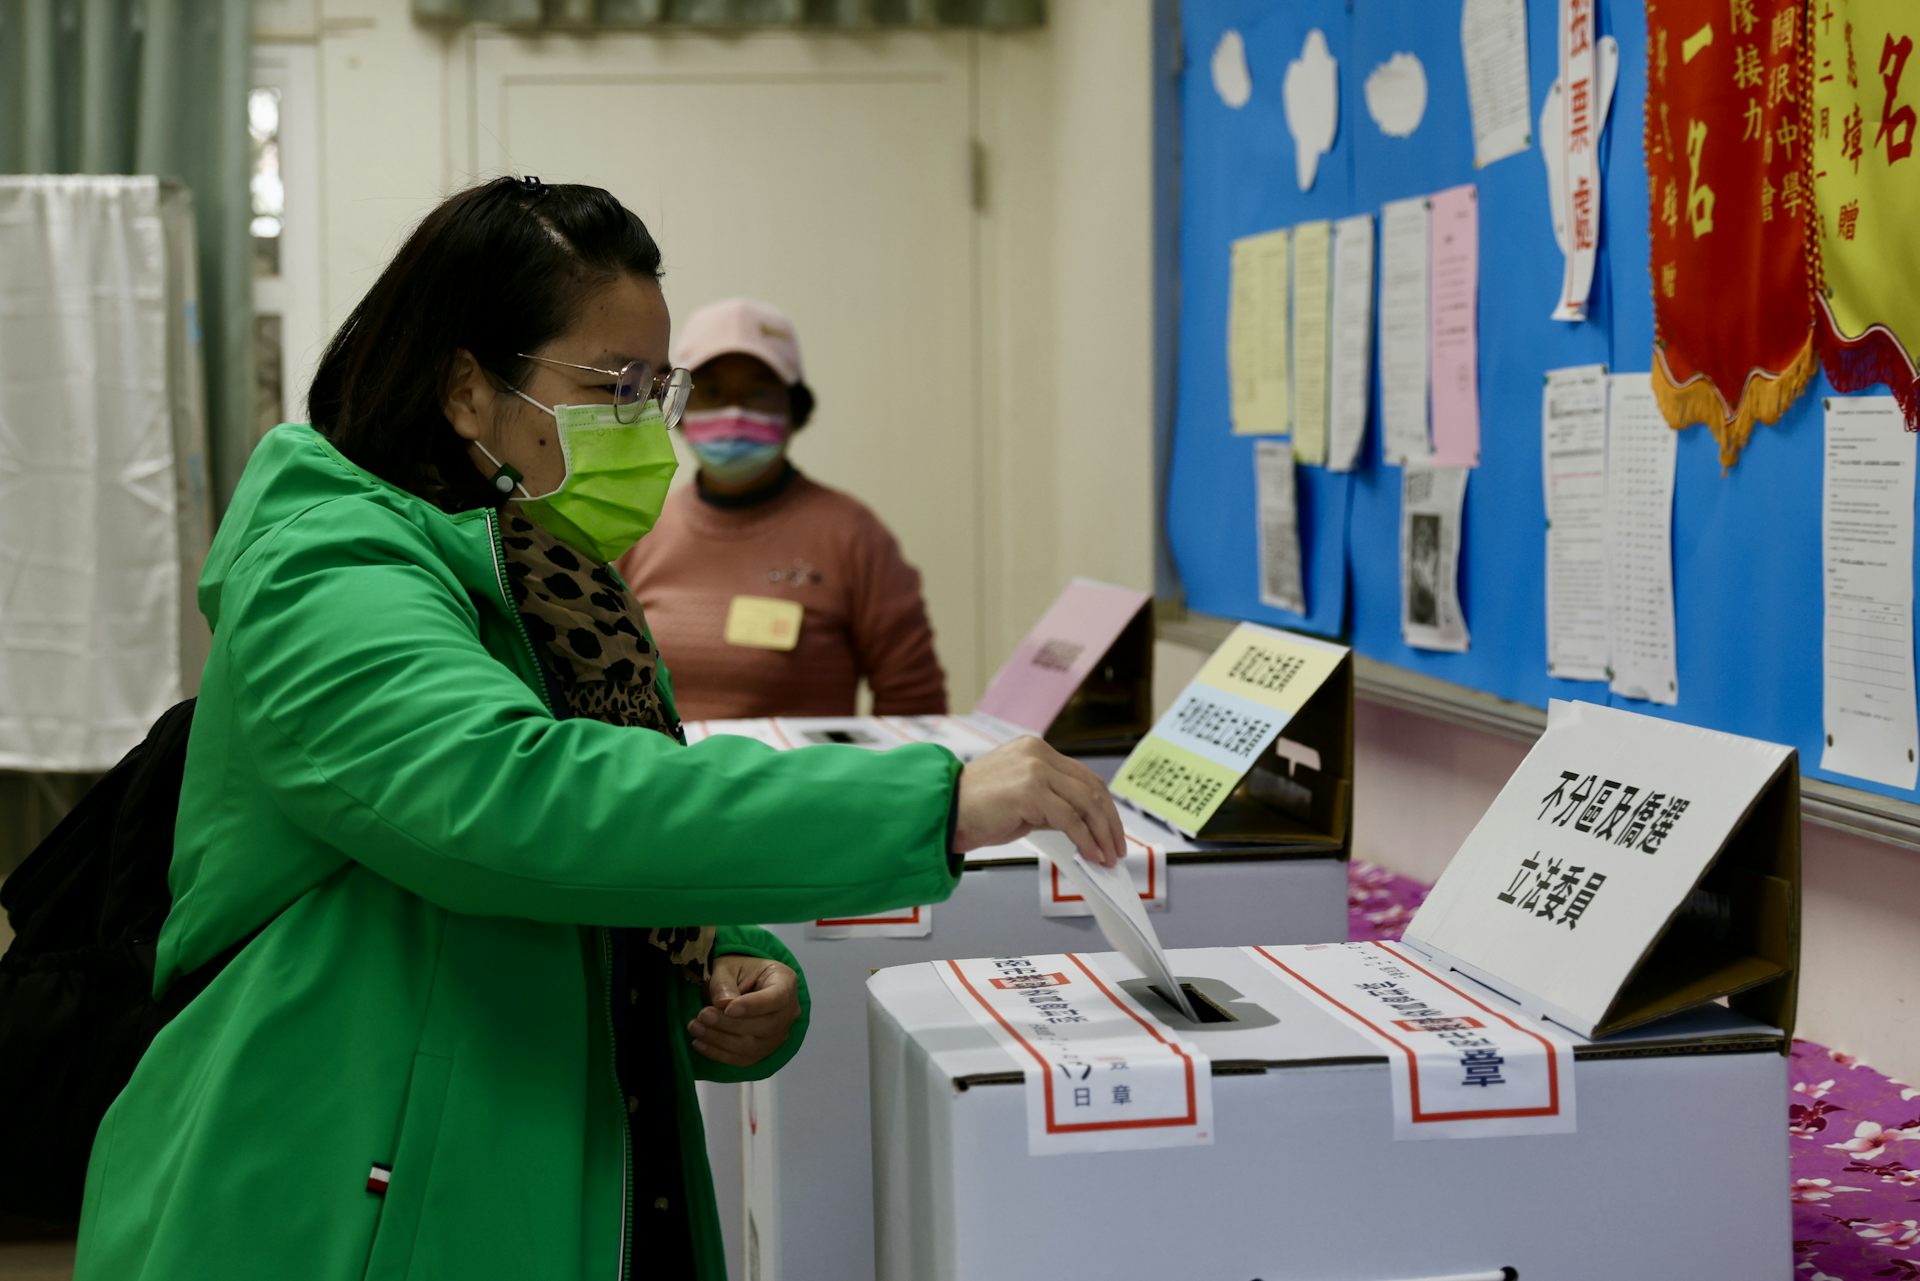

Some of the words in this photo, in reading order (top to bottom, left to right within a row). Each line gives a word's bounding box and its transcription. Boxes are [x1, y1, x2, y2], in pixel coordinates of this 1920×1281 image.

[1873, 32, 1918, 167] 名
[1537, 770, 1691, 855] 不分區及僑選
[1497, 850, 1608, 931] 立法委員
